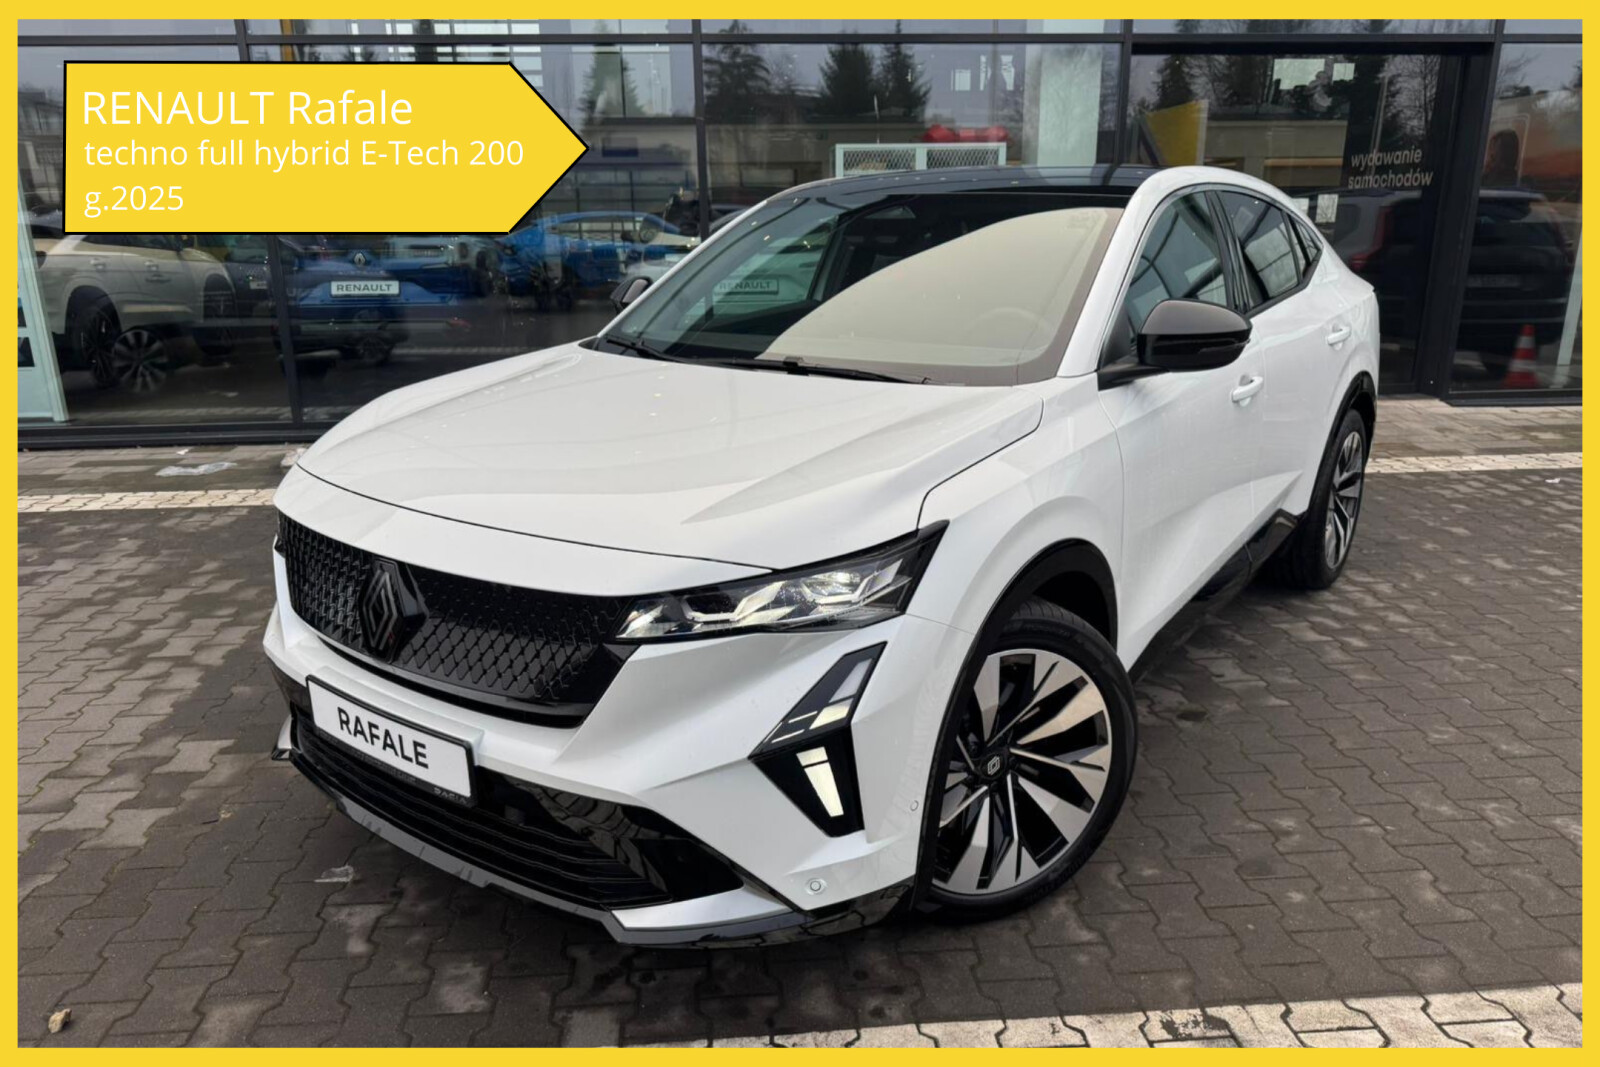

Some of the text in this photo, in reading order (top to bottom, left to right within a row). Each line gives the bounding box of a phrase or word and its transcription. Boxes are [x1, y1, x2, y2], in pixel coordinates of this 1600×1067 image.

[1351, 144, 1422, 171] wydawanie
[1347, 167, 1434, 190] samochodów
[336, 283, 393, 292] RENAULT
[337, 706, 429, 770] RAFALE
